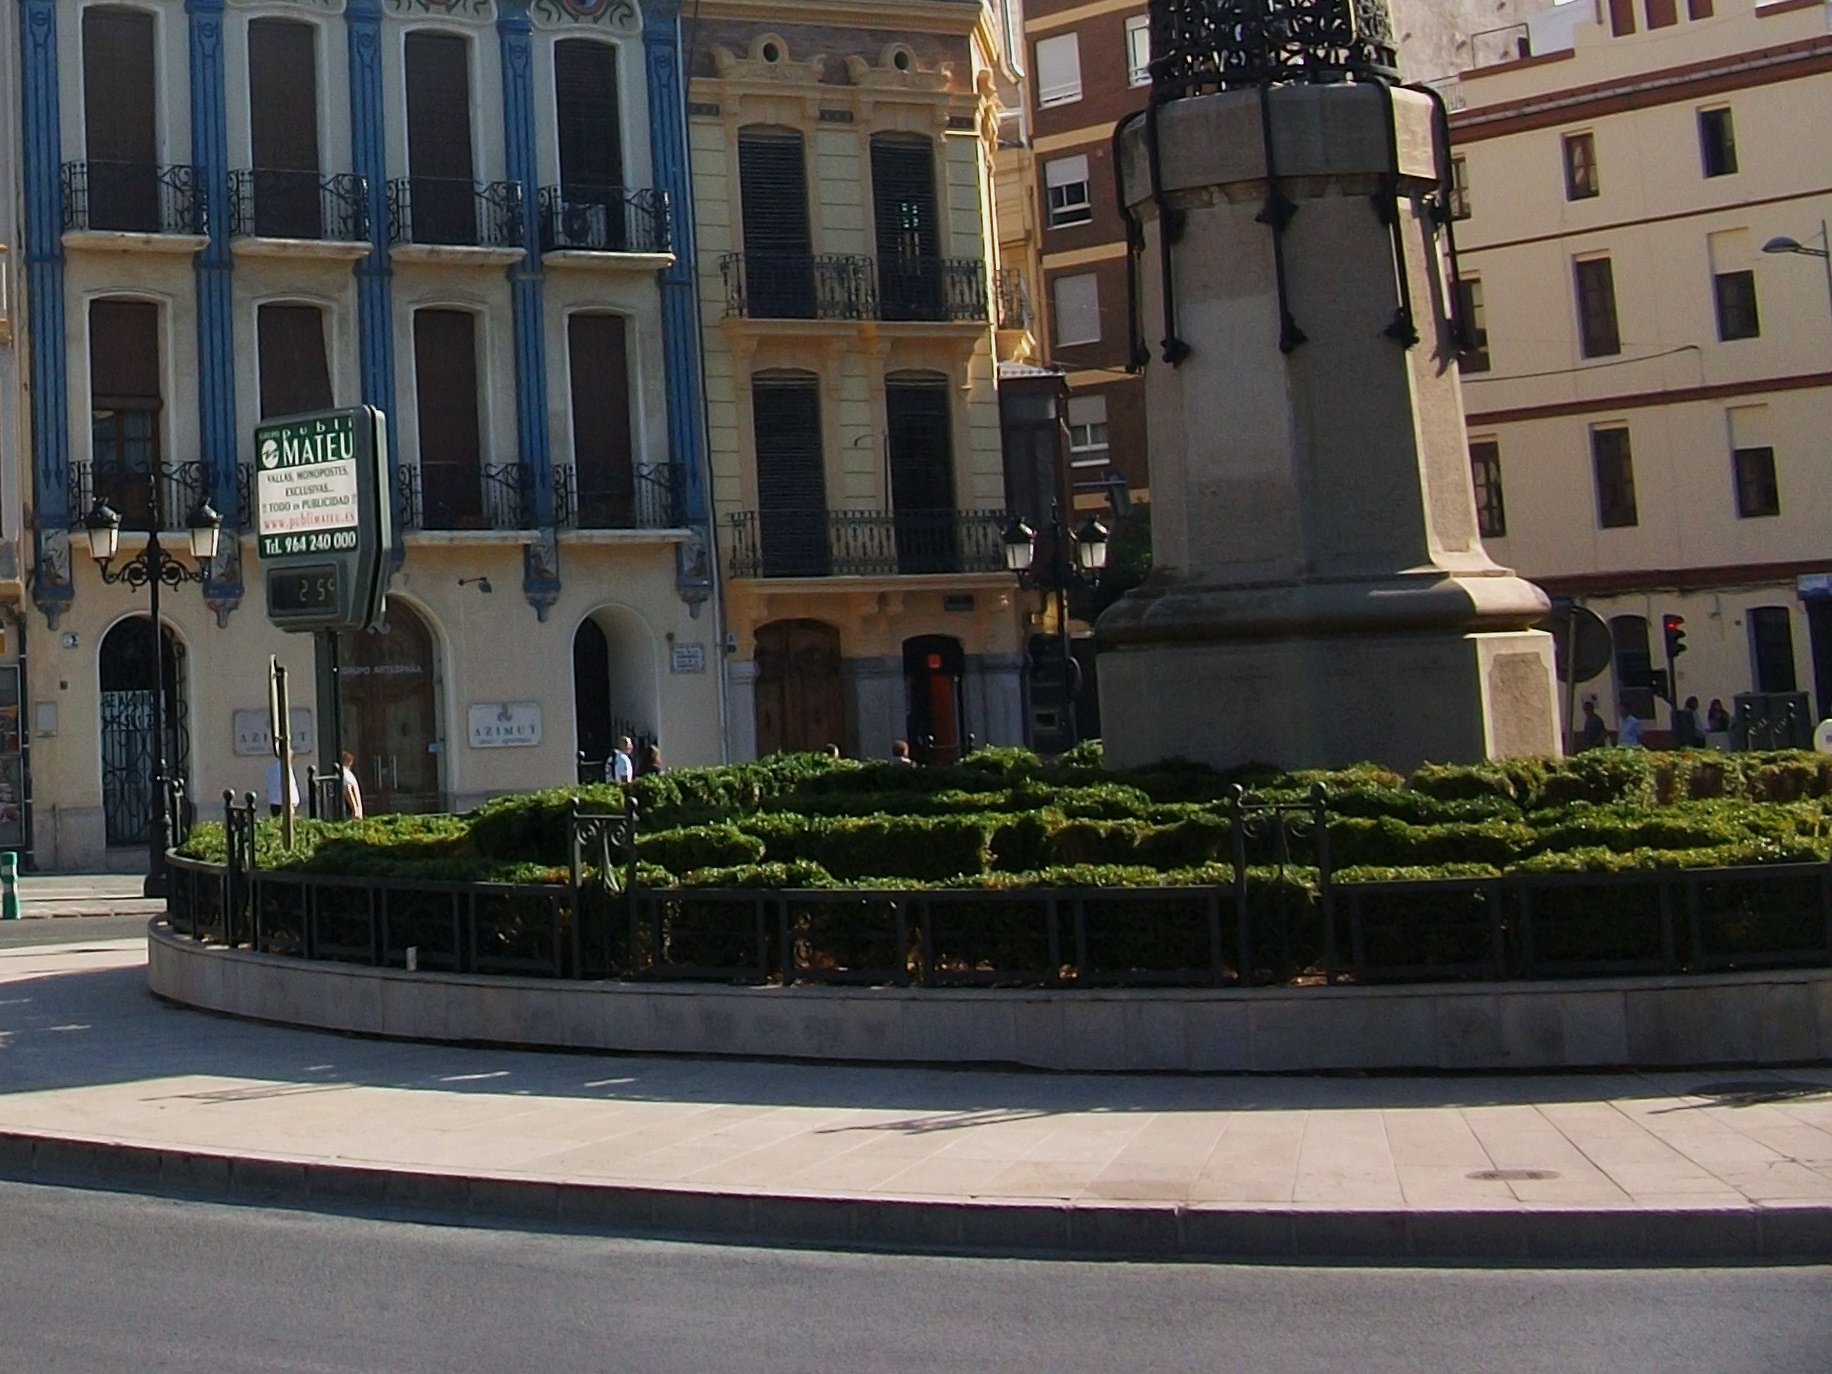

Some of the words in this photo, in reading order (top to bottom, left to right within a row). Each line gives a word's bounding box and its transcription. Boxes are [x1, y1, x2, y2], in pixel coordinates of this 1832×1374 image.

[282, 431, 353, 466] MATEU
[269, 502, 290, 512] TODO
[302, 495, 350, 509] PUBLICIDAD
[285, 535, 306, 553] 964
[309, 533, 331, 551] 240
[334, 531, 356, 549] 000
[474, 724, 536, 737] AZIMUT
